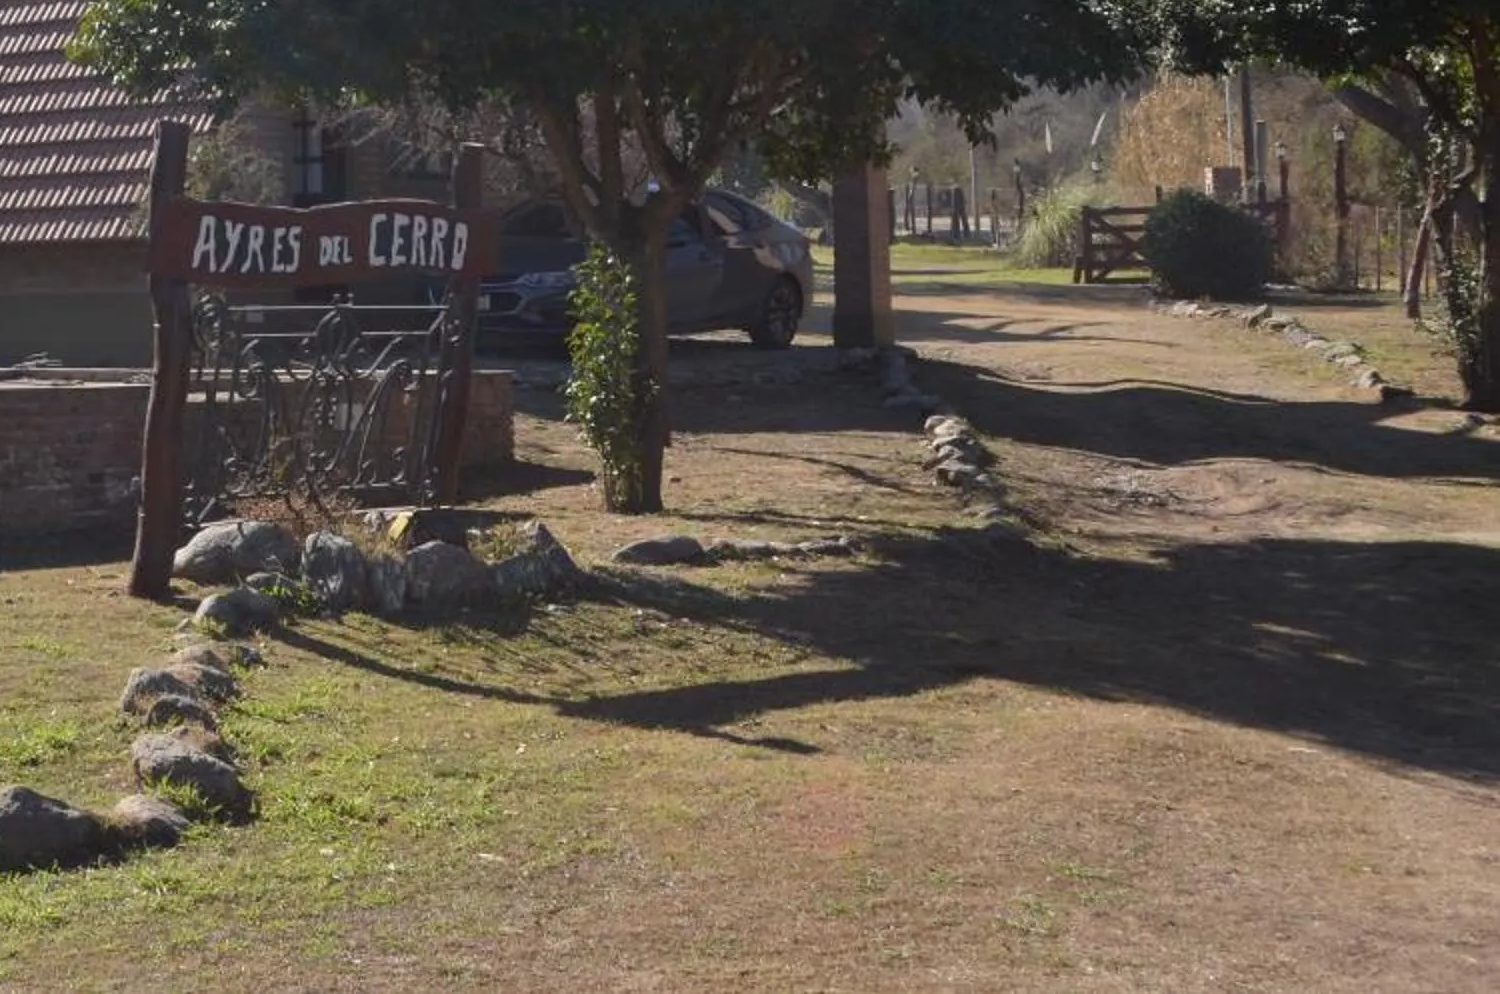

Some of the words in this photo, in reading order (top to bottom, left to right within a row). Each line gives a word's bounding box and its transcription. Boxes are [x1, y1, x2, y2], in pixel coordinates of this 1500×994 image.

[192, 215, 303, 273] AYRES
[319, 235, 353, 266] DEL
[368, 213, 469, 271] CERRO
